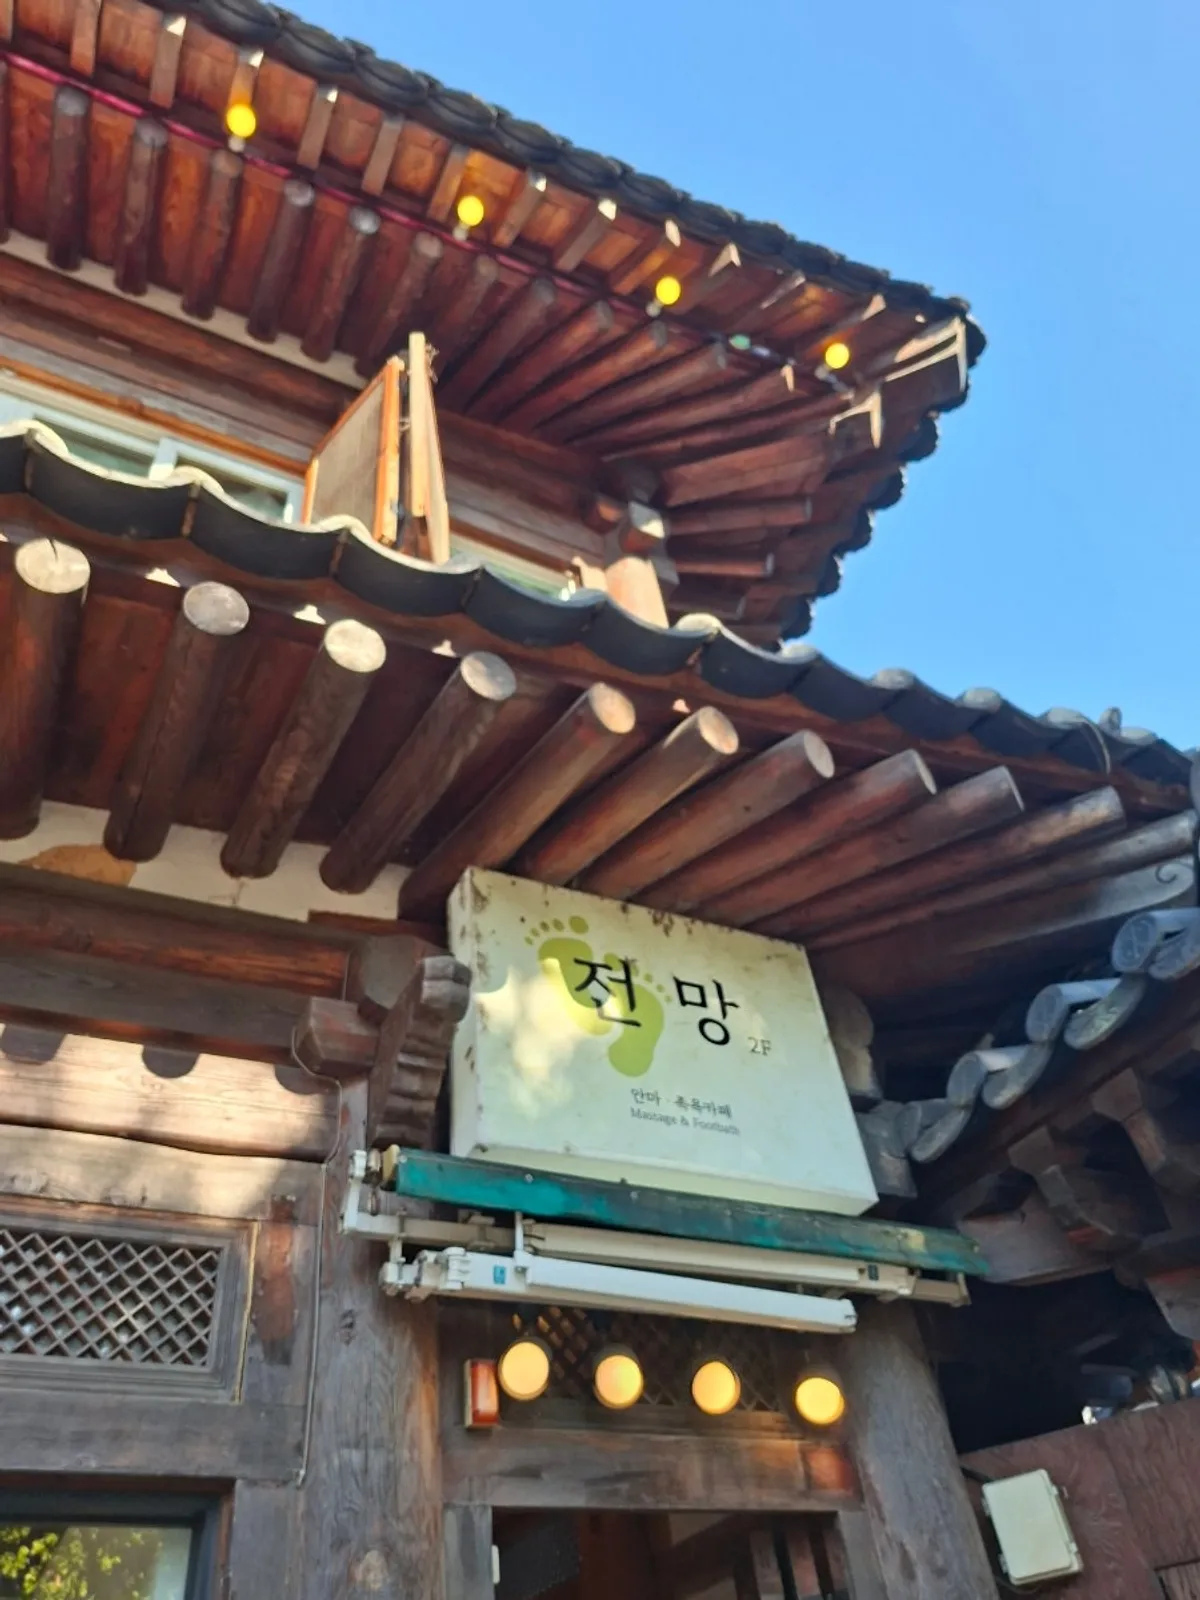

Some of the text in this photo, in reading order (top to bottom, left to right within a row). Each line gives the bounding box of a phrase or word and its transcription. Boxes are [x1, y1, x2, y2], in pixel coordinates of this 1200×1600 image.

[573, 957, 772, 1055] 전망 2F
[630, 1088, 662, 1106] 안마
[630, 1106, 677, 1126] Massage
